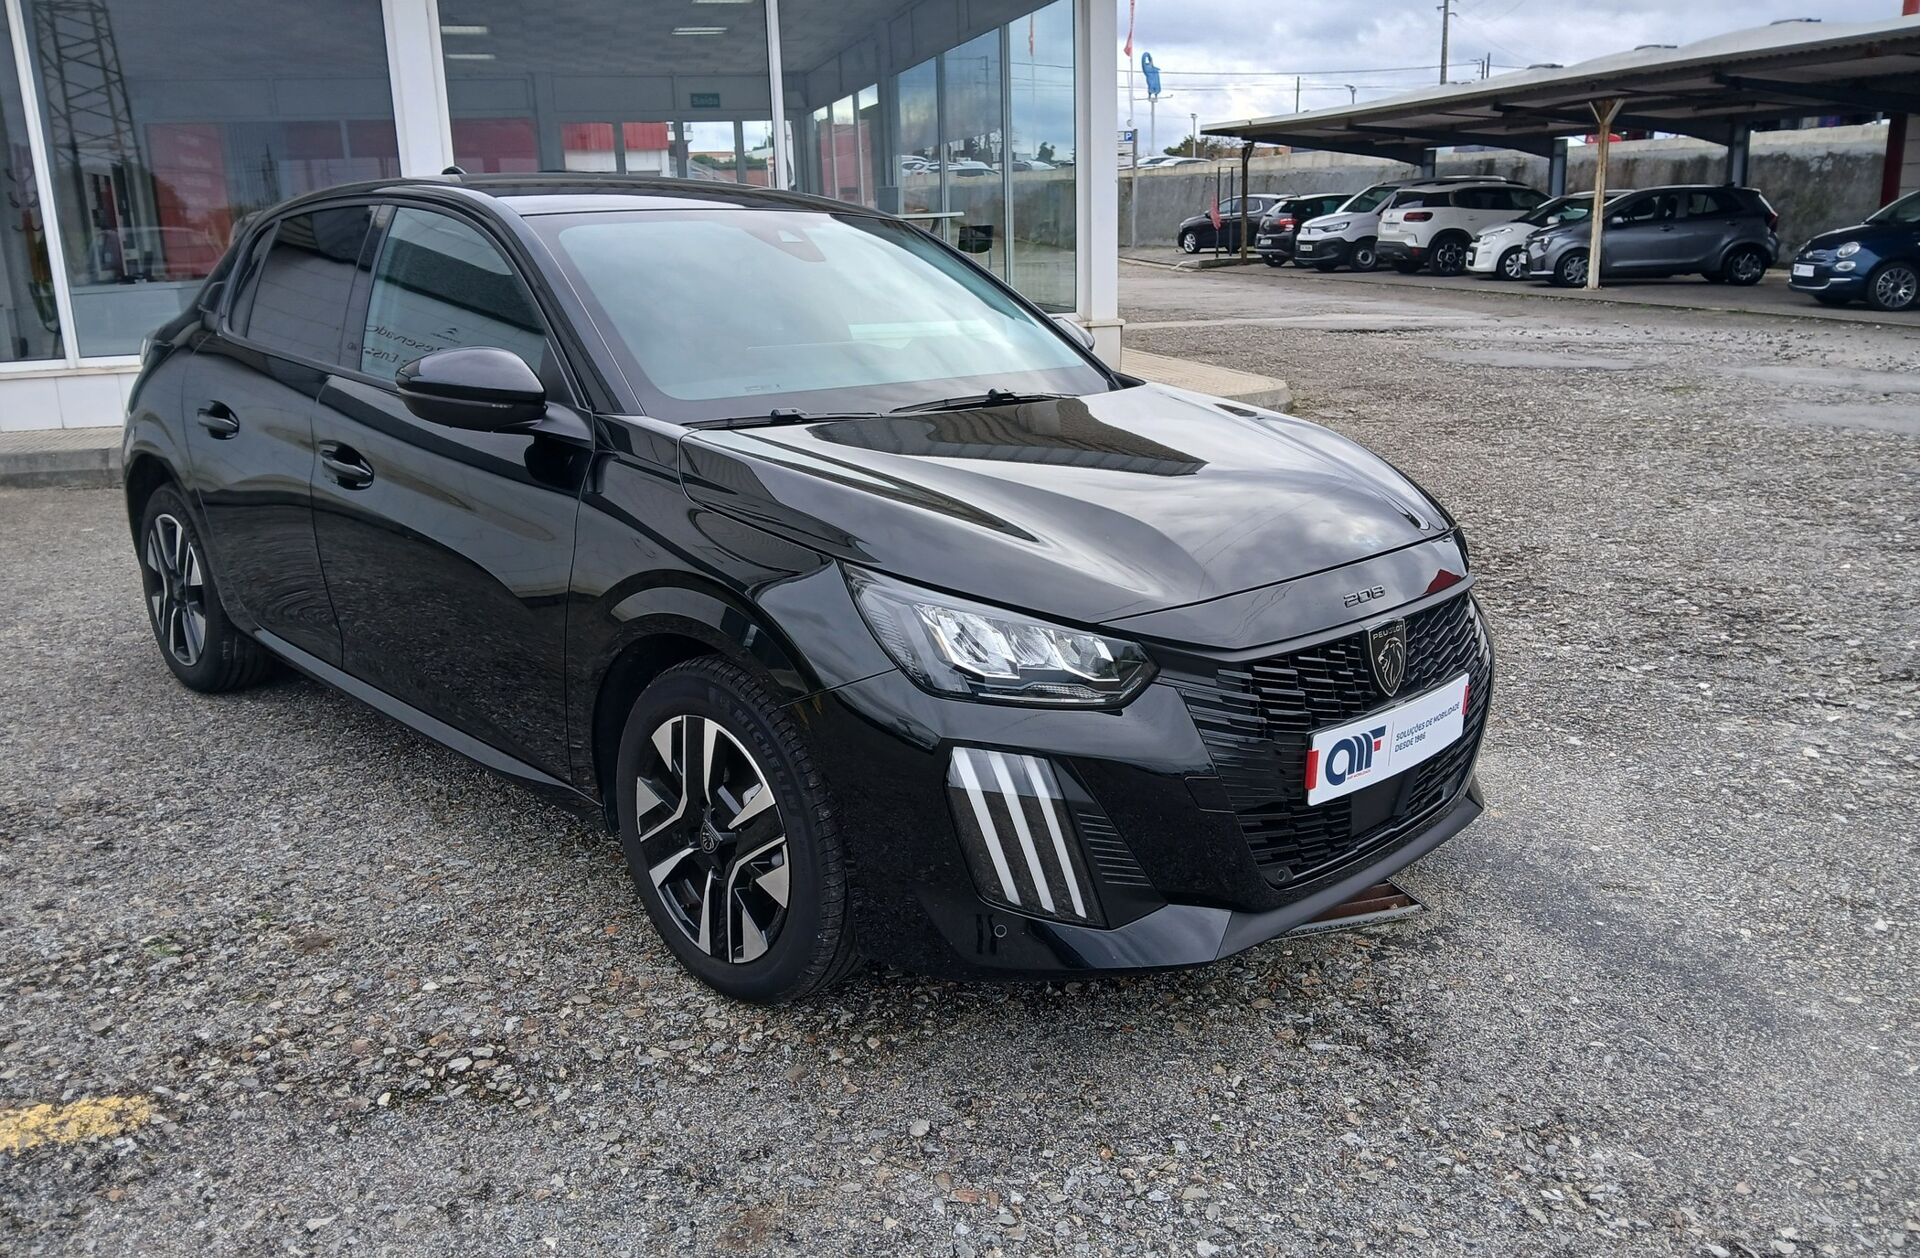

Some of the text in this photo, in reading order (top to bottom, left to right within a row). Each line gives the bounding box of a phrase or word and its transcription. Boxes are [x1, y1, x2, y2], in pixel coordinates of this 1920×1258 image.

[1344, 585, 1386, 608] 208
[1396, 701, 1461, 741] SOLUÇÕES DE MOBILIDADE
[735, 709, 801, 811] MICHELIN
[1395, 737, 1414, 753] DESDE
